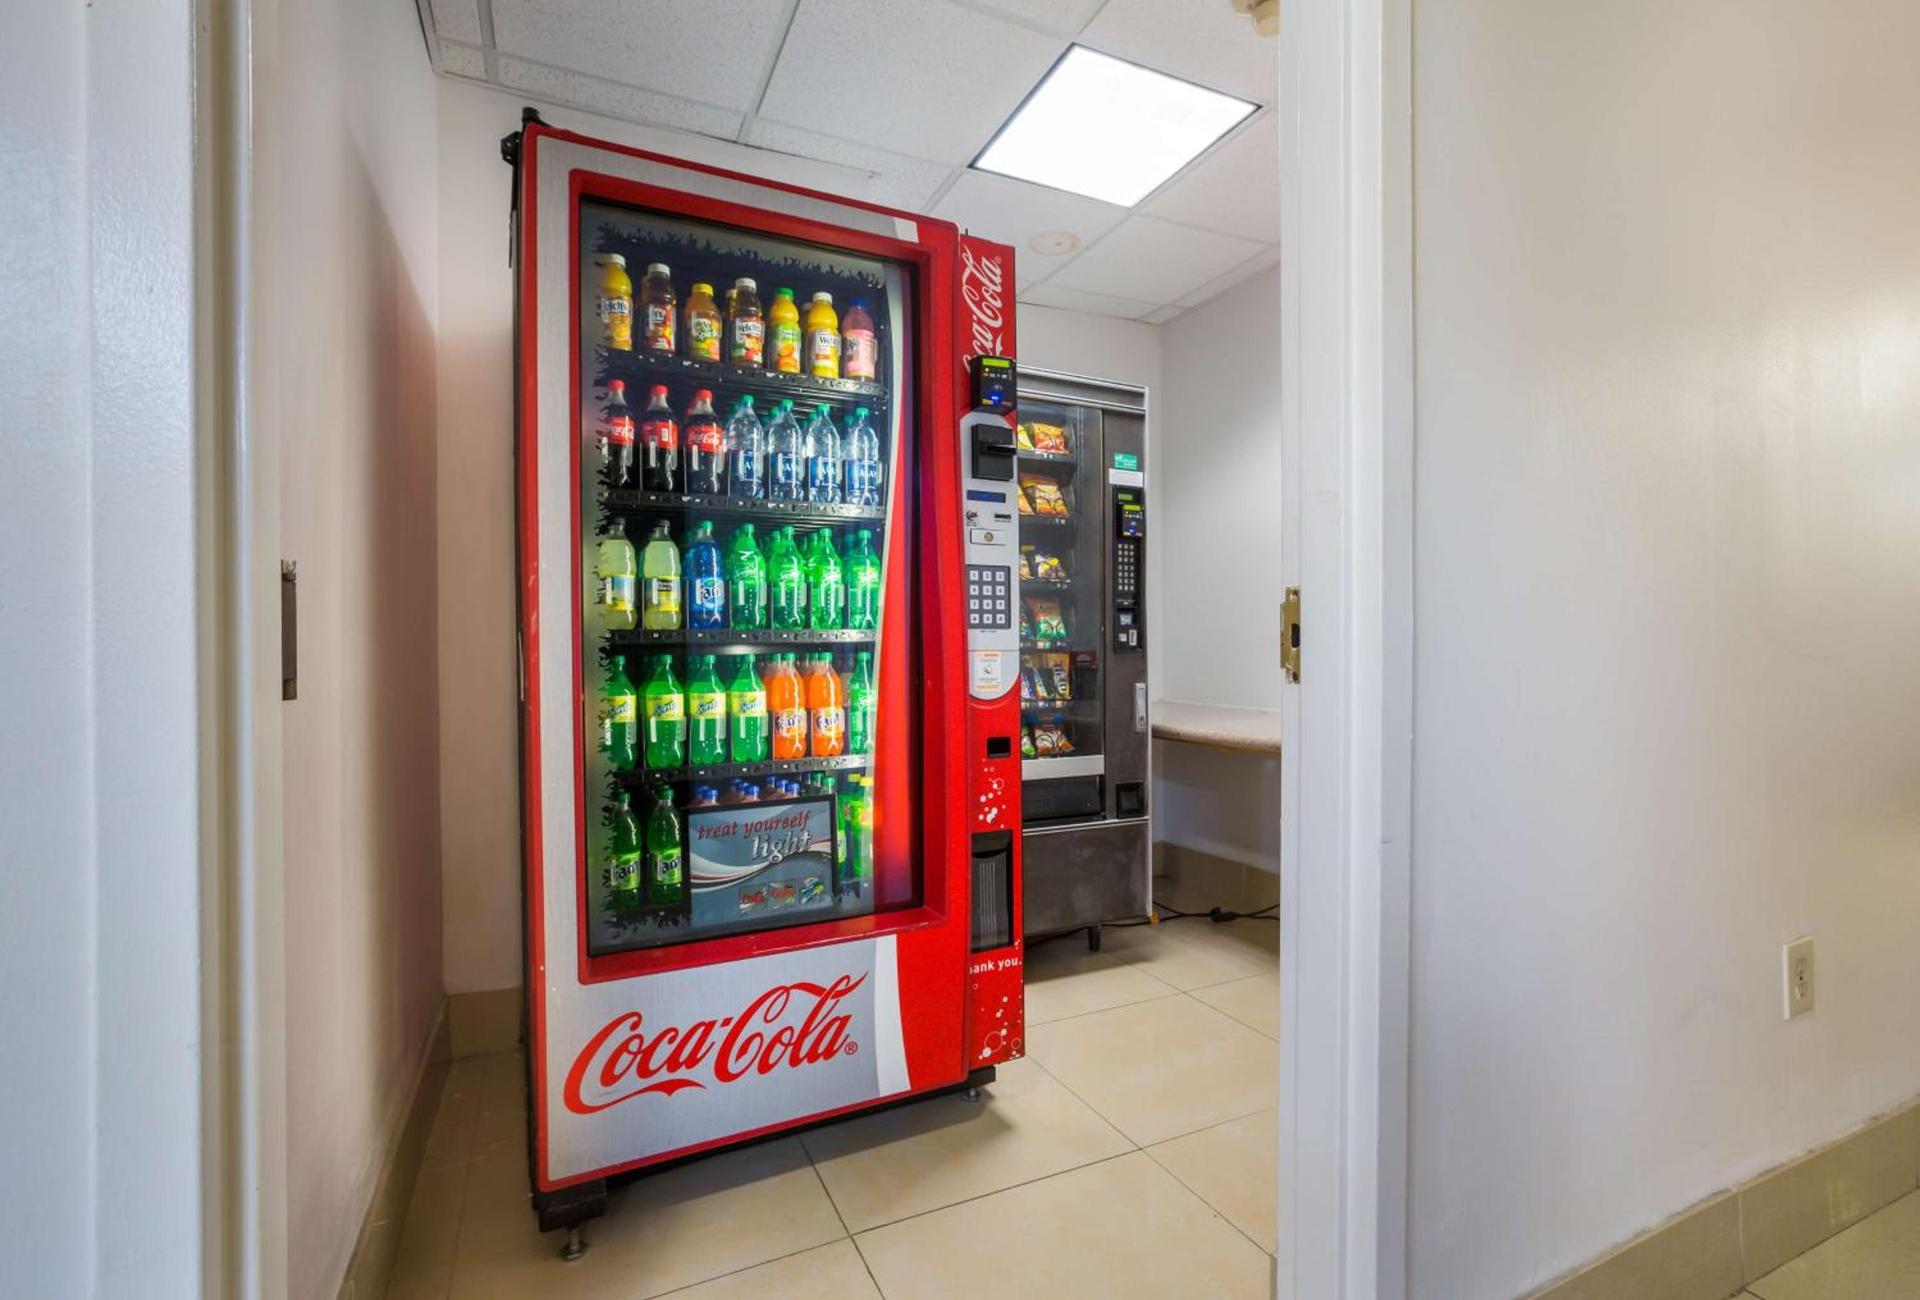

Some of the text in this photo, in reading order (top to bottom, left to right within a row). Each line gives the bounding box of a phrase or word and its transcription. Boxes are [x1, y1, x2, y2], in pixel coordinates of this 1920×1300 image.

[962, 244, 1003, 374] ca-Cola
[696, 809, 812, 840] treat yourself
[751, 830, 813, 864] light
[563, 970, 869, 1115] Coca-Cola
